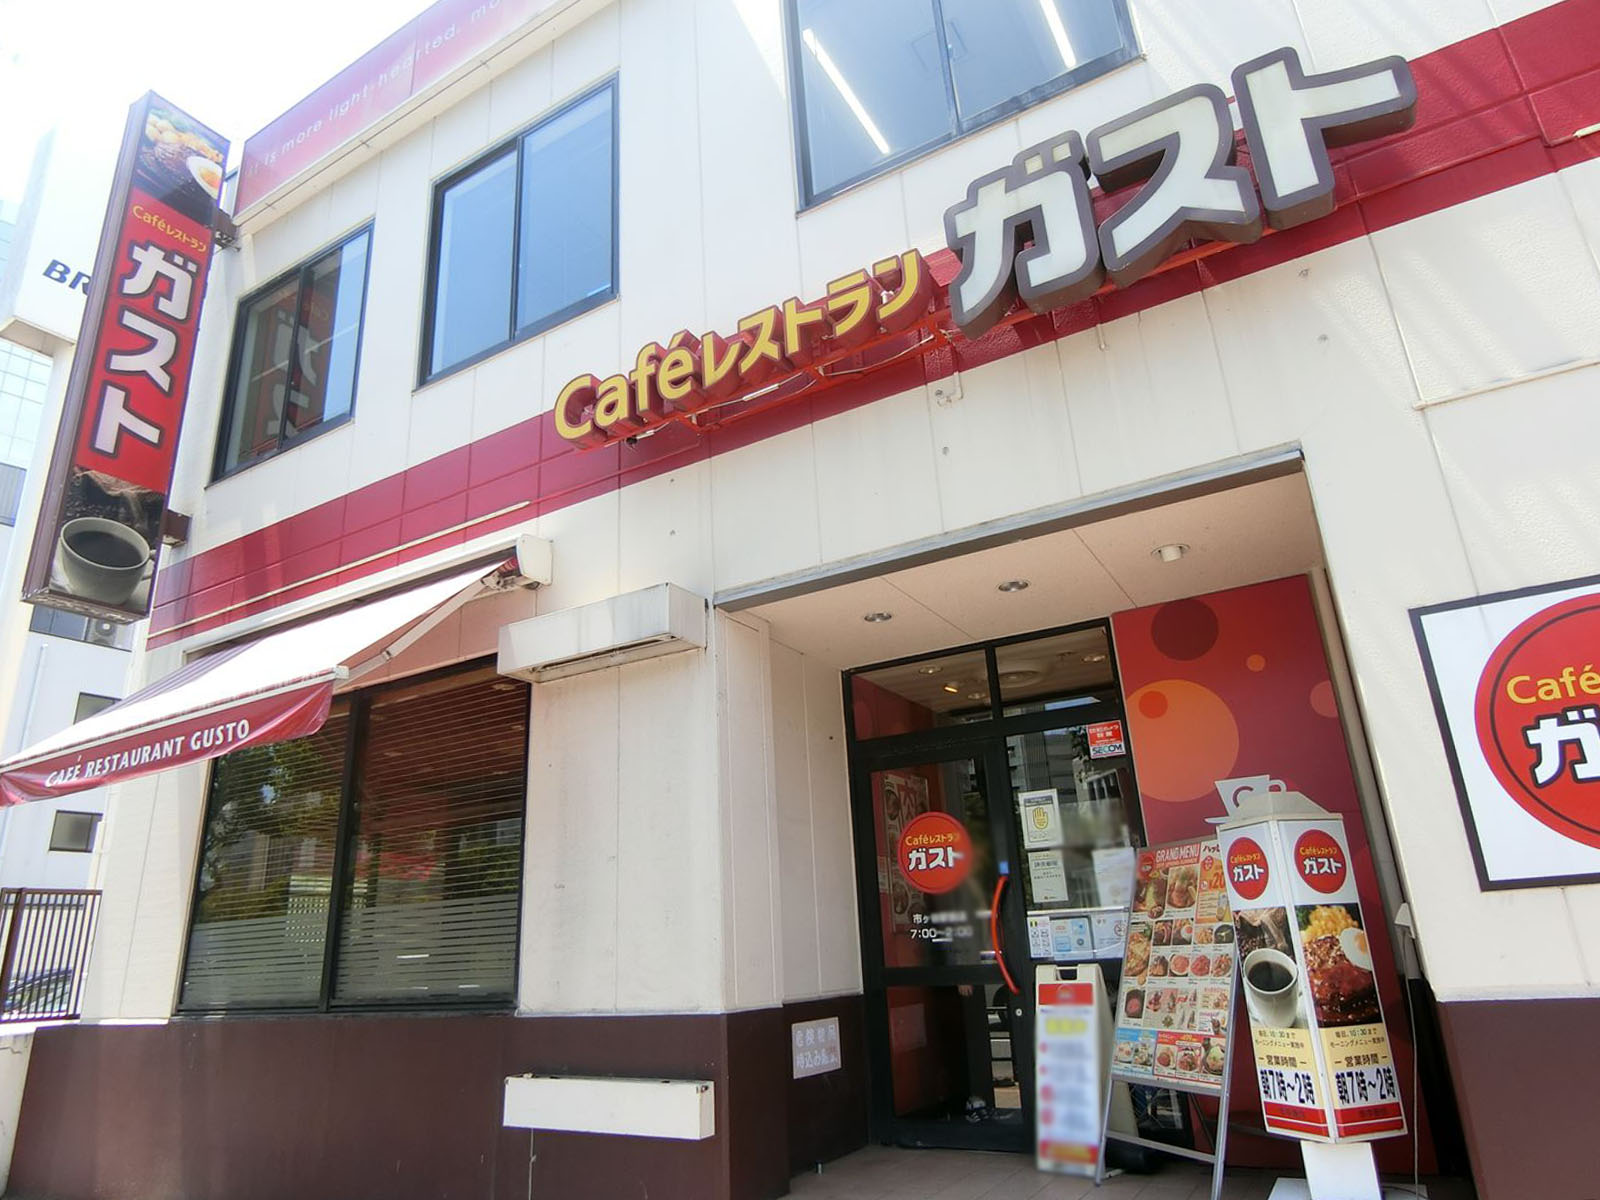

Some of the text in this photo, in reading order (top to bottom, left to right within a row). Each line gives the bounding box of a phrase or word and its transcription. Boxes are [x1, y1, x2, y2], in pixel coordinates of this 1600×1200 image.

[281, 119, 324, 154] more
[944, 47, 1417, 327] ガスト
[132, 205, 207, 252] Caféレストラン
[93, 241, 198, 456] ガスト
[554, 248, 921, 440] Caféレストラン
[1506, 664, 1600, 704] Café
[45, 719, 250, 788] CAFÉ RESTAURANT GUSTO
[1092, 744, 1122, 754] SECOM
[908, 846, 964, 871] ガスト
[1232, 864, 1264, 882] ガスト
[1303, 857, 1342, 875] ガスト
[1266, 1055, 1298, 1068] 営業時間
[1345, 1053, 1379, 1067] 営業時間
